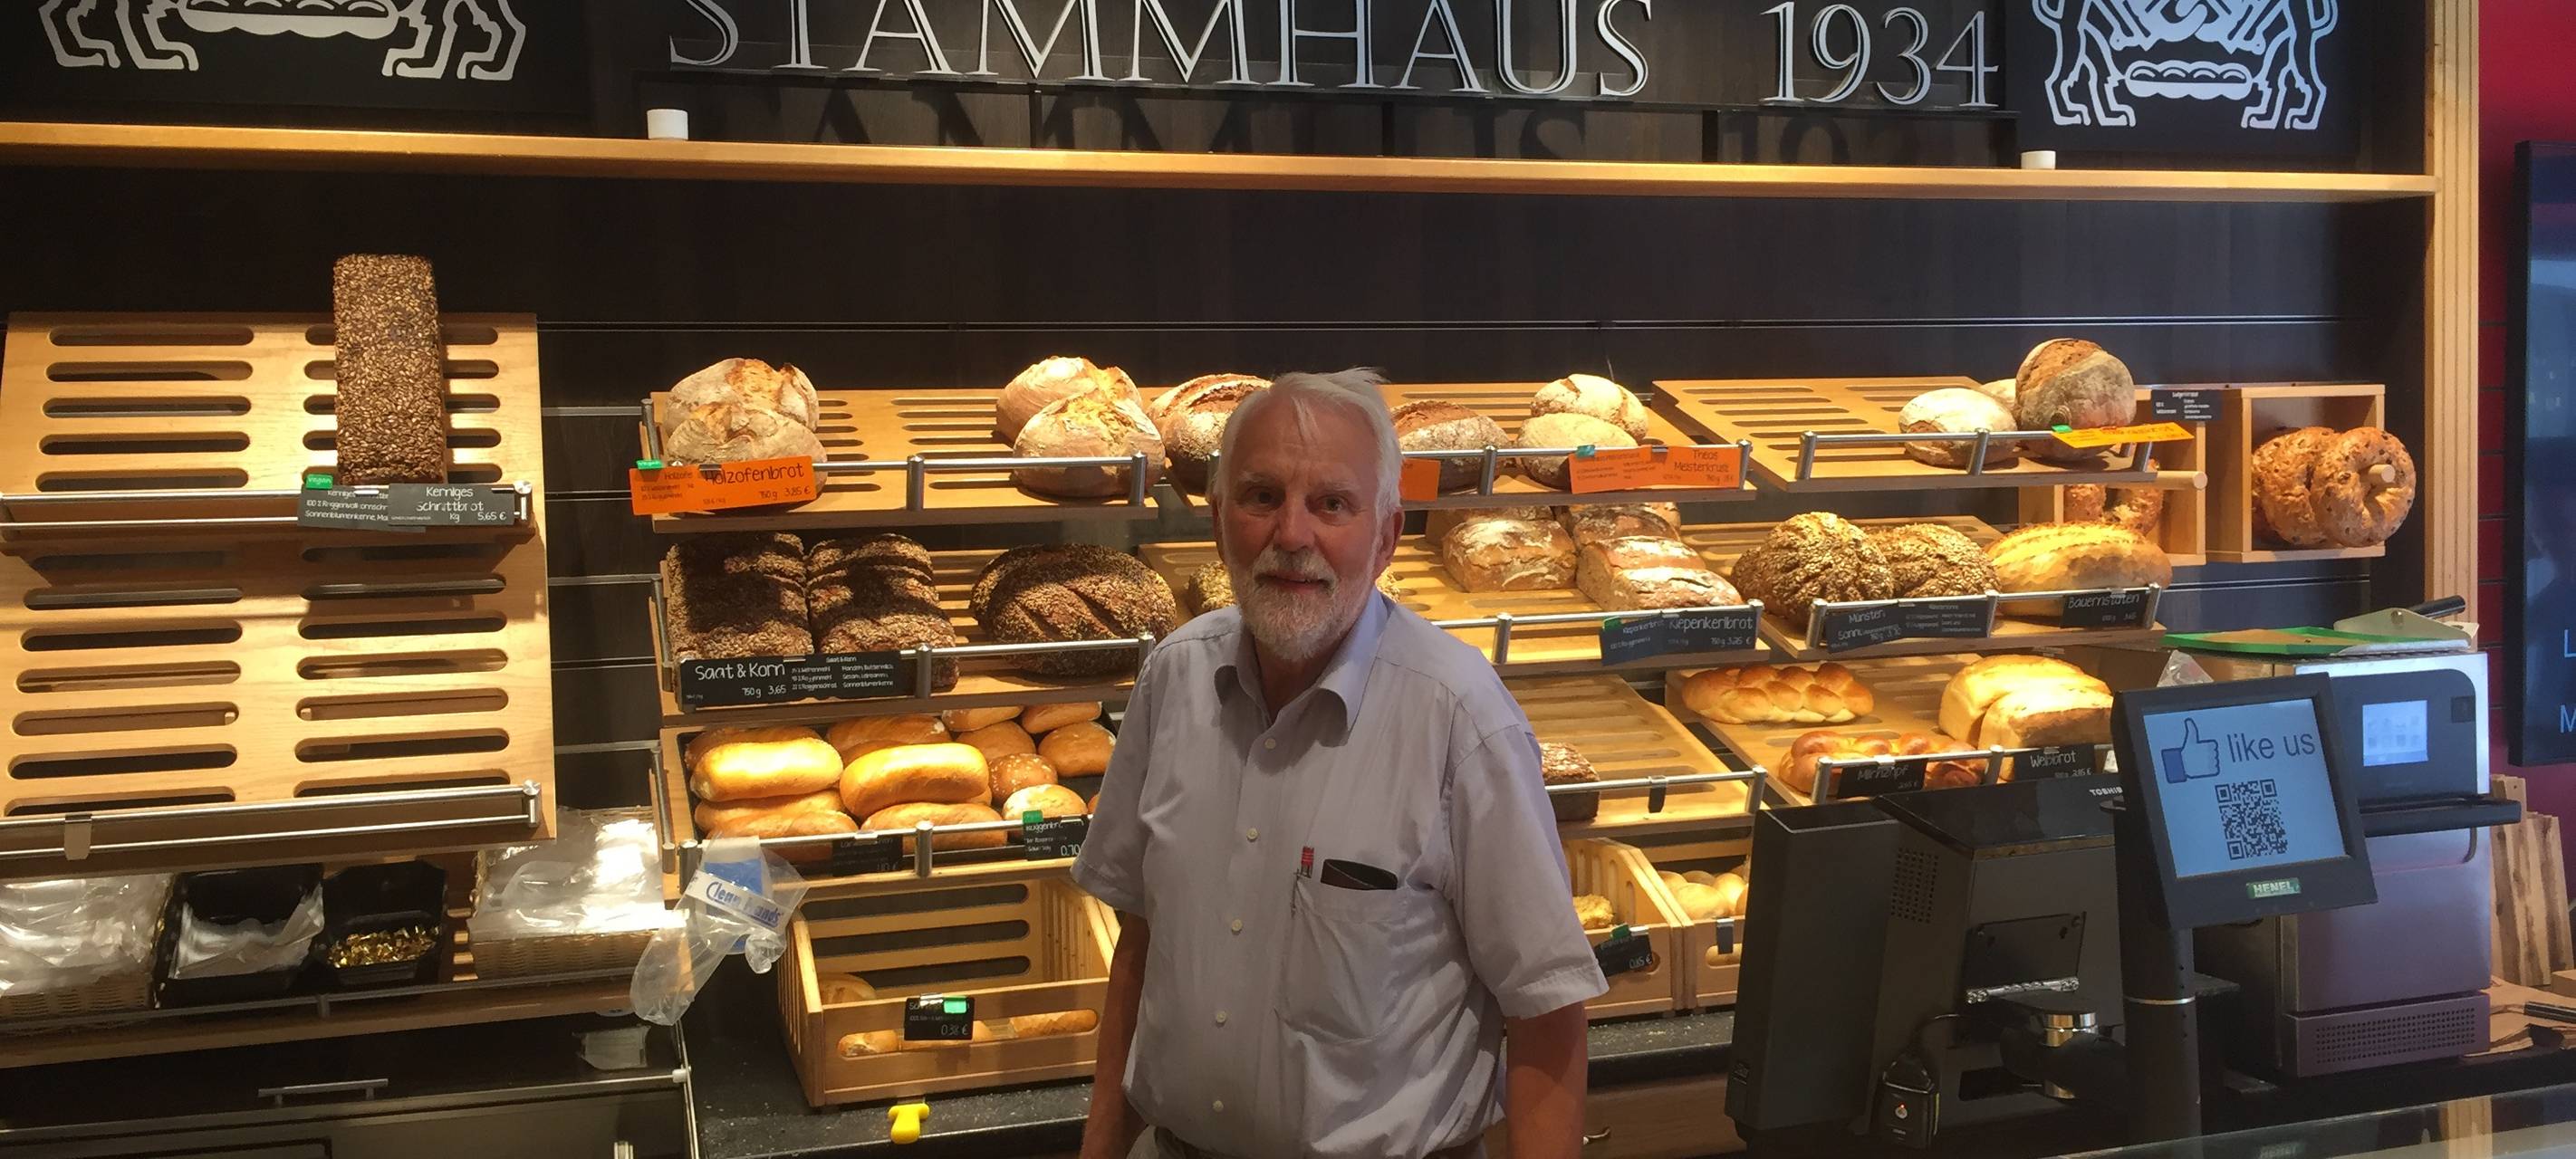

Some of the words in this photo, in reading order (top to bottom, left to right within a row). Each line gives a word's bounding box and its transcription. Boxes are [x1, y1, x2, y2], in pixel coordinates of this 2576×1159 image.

[668, 0, 1654, 98] STAMMHAUS
[1759, 1, 2000, 108] 1934
[705, 463, 804, 485] Holzofenbrot
[426, 486, 474, 501] Kerniges
[477, 512, 498, 522] 5,65
[499, 512, 507, 521] €
[695, 663, 735, 681] Saat
[736, 663, 747, 679] &
[749, 662, 786, 678] Korn
[742, 687, 755, 696] 750
[755, 688, 762, 699] g
[767, 685, 787, 695] 3,65
[2226, 733, 2275, 763] like
[2283, 732, 2316, 757] us
[2089, 786, 2124, 797] TOSHIB
[706, 881, 742, 905] Clean
[2253, 881, 2294, 894] HENEL
[962, 1024, 970, 1036] €
